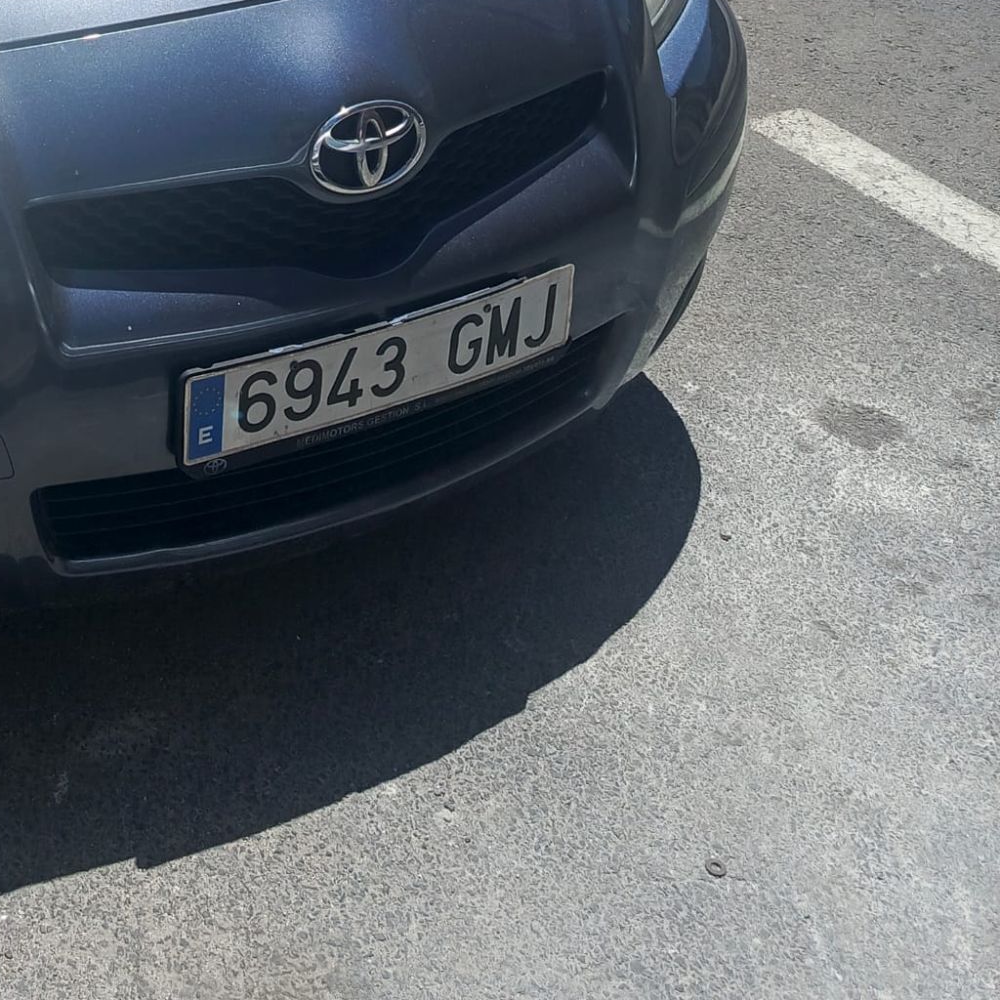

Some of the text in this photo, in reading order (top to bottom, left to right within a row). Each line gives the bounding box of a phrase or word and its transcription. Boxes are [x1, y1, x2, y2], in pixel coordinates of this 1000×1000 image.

[237, 284, 558, 434] 6943 GMJ
[197, 425, 213, 445] E
